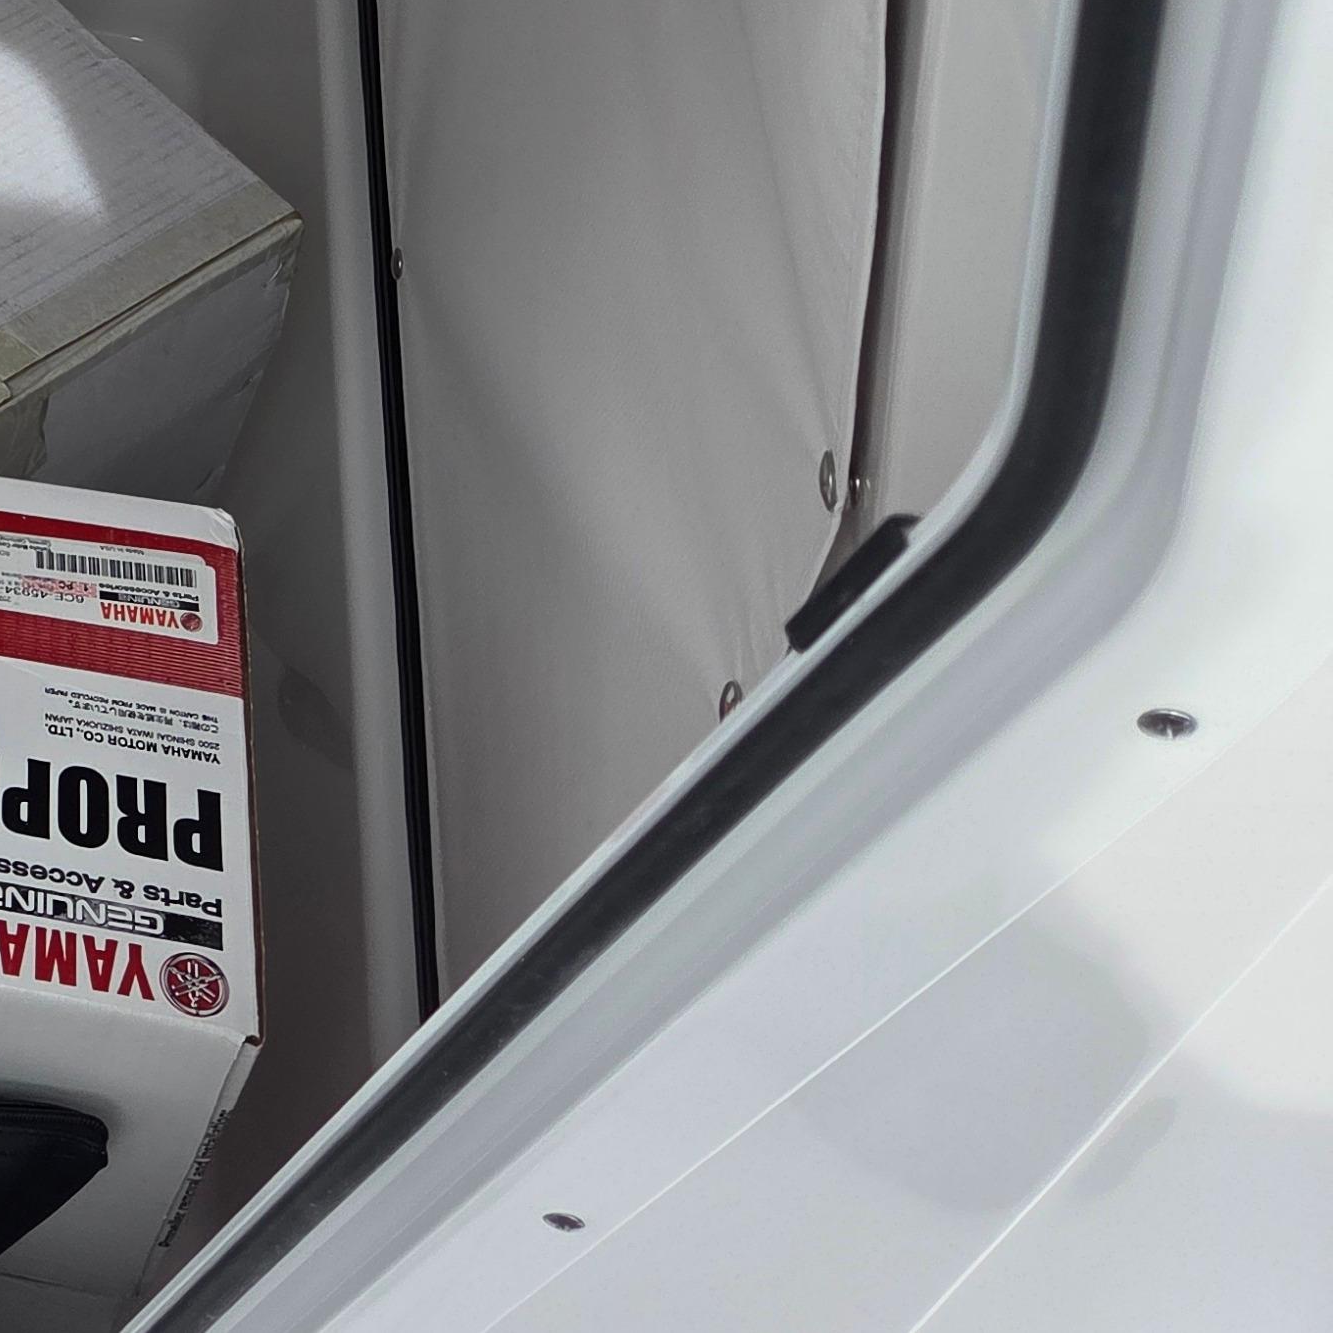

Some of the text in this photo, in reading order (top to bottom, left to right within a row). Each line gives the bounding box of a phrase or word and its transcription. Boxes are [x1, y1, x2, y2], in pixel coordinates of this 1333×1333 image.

[99, 582, 160, 596] Accessories
[100, 601, 179, 629] YAMAHA
[112, 699, 133, 708] FROM
[135, 703, 156, 712] MADE
[45, 713, 220, 750] 2500 SHINGAI IWATA SHIZUOKA JAPAN
[45, 724, 220, 764] YAMAHA MOTOR CO., LTD.
[111, 878, 135, 899] &
[143, 883, 222, 918] Parts
